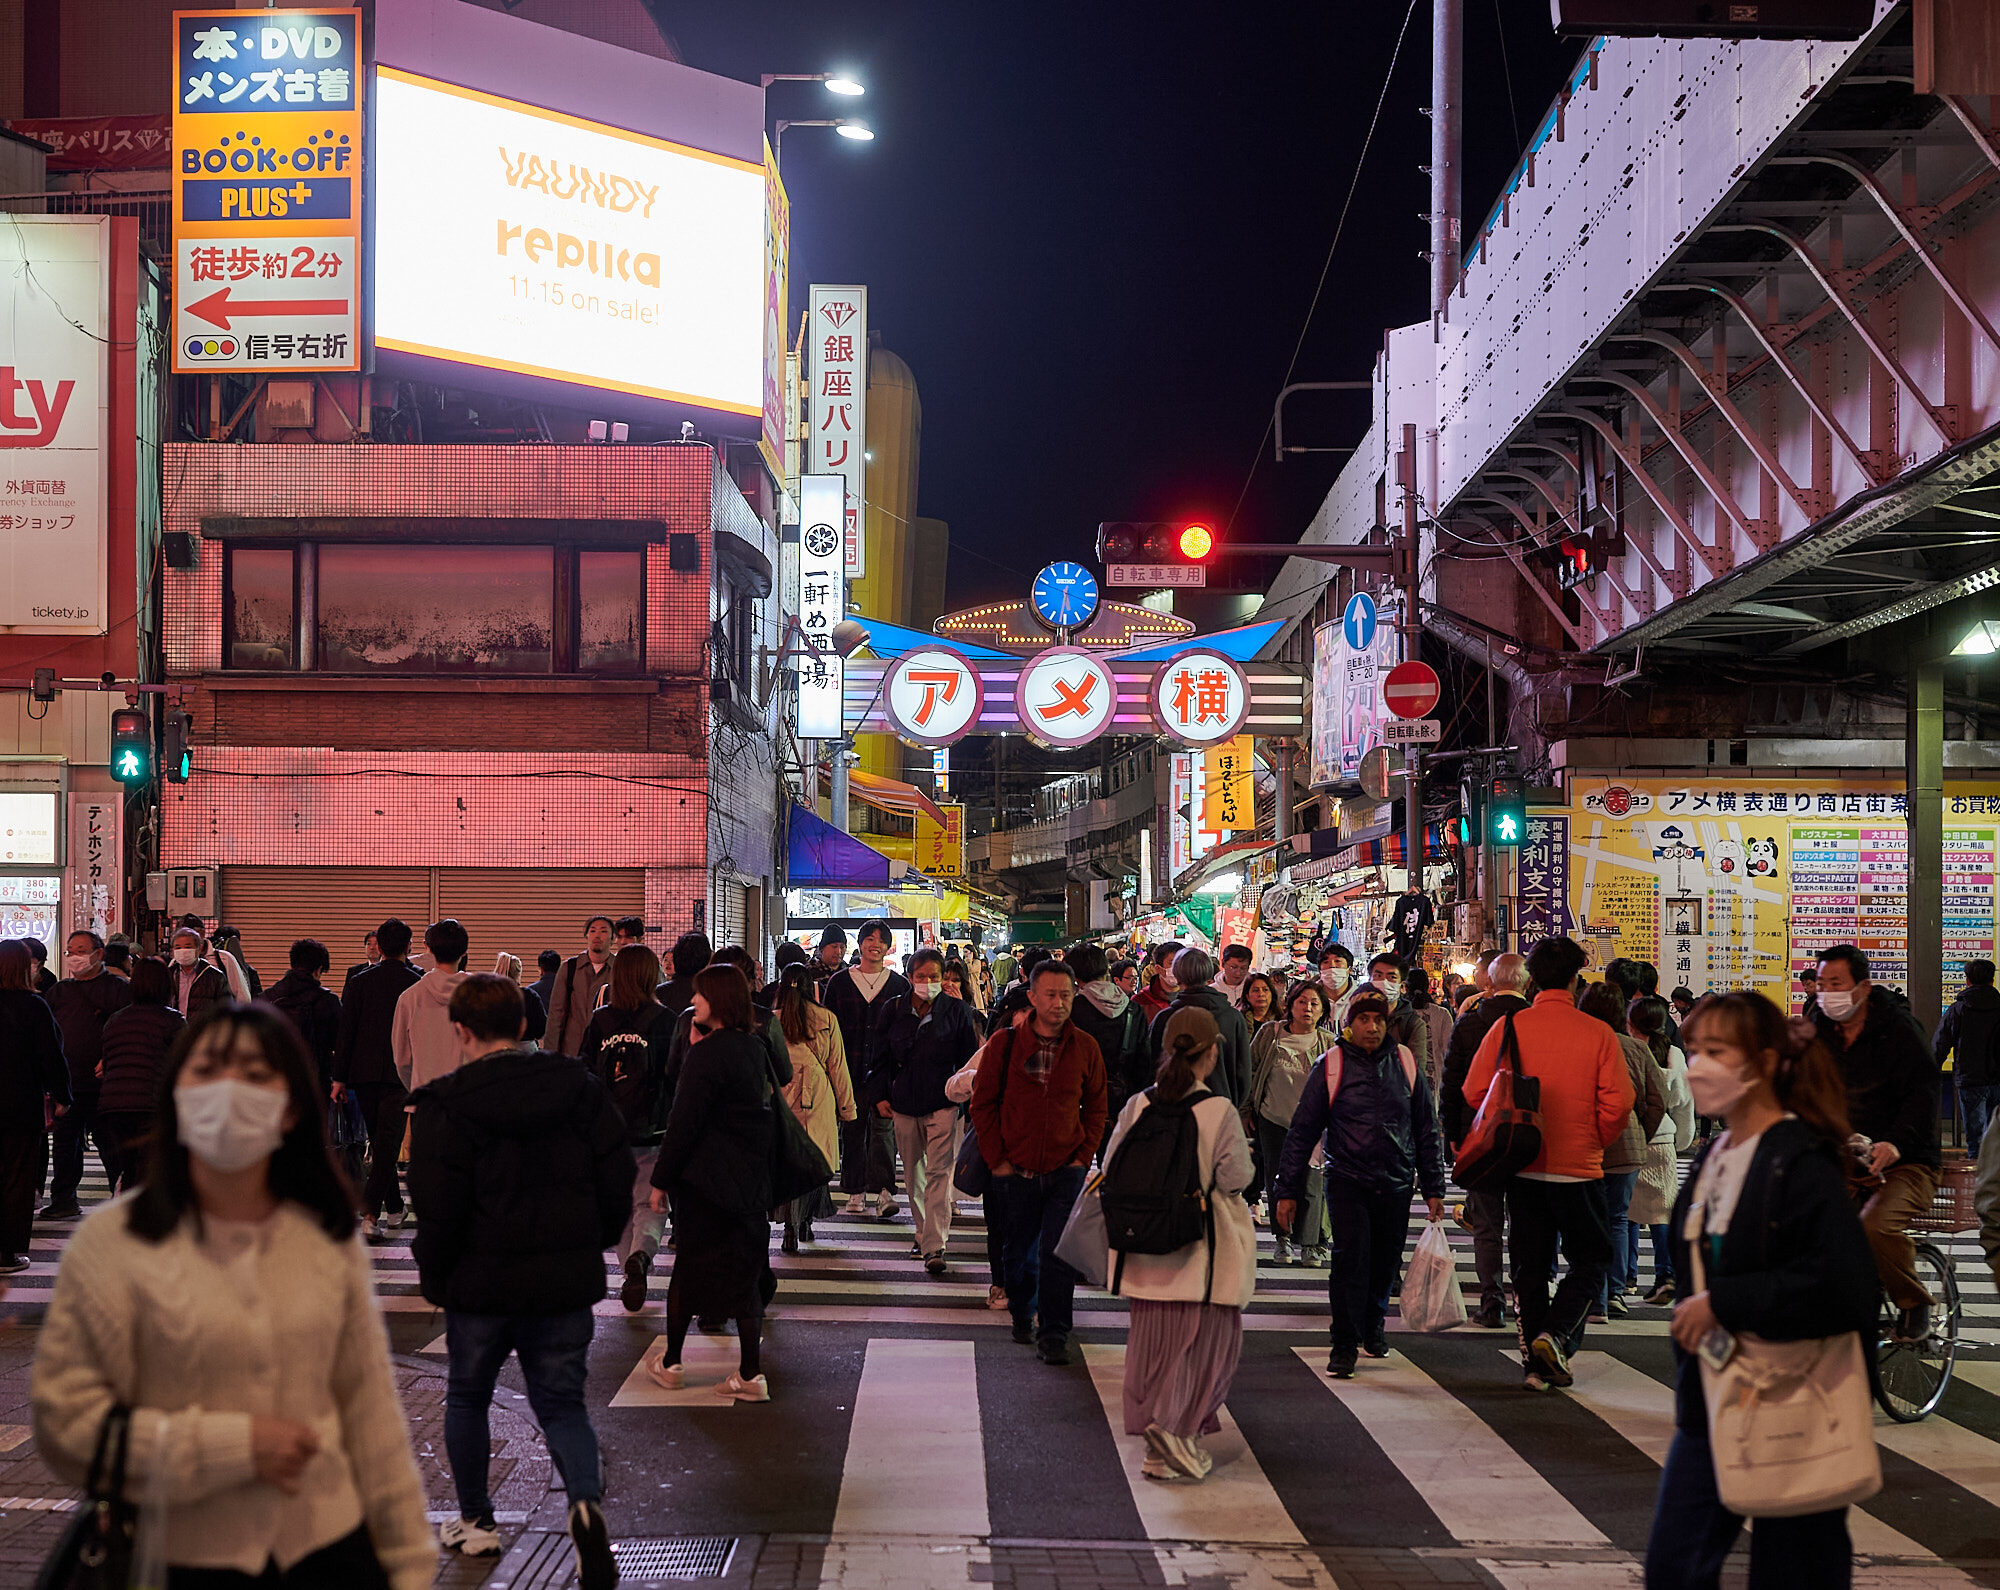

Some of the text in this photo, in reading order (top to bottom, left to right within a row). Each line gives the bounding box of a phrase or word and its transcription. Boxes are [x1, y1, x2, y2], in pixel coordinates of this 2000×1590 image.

[193, 27, 342, 62] 本・DVD
[184, 68, 350, 104] メンズ古着
[498, 146, 660, 219] VAUNDY
[497, 218, 660, 288] replica
[190, 246, 343, 281] 徒歩約2分
[508, 274, 660, 326] 11.15 on sale!
[245, 334, 349, 359] 信号右折
[821, 334, 854, 499] 銀座パリ
[5, 480, 66, 495] 外貨両替
[30, 497, 76, 508] Exchange
[1113, 566, 1201, 582] 自転車専用
[32, 606, 89, 619] tickety.jp
[1349, 671, 1355, 682] 8
[1364, 667, 1374, 679] 20
[1387, 726, 1436, 739] 自転車を除く
[933, 830, 944, 864] プラザ
[1794, 852, 1835, 860] ロンドンスポーツ
[938, 864, 955, 873] 入口
[26, 879, 44, 887] 380
[26, 890, 44, 899] 790
[1552, 913, 1562, 935] 毎月
